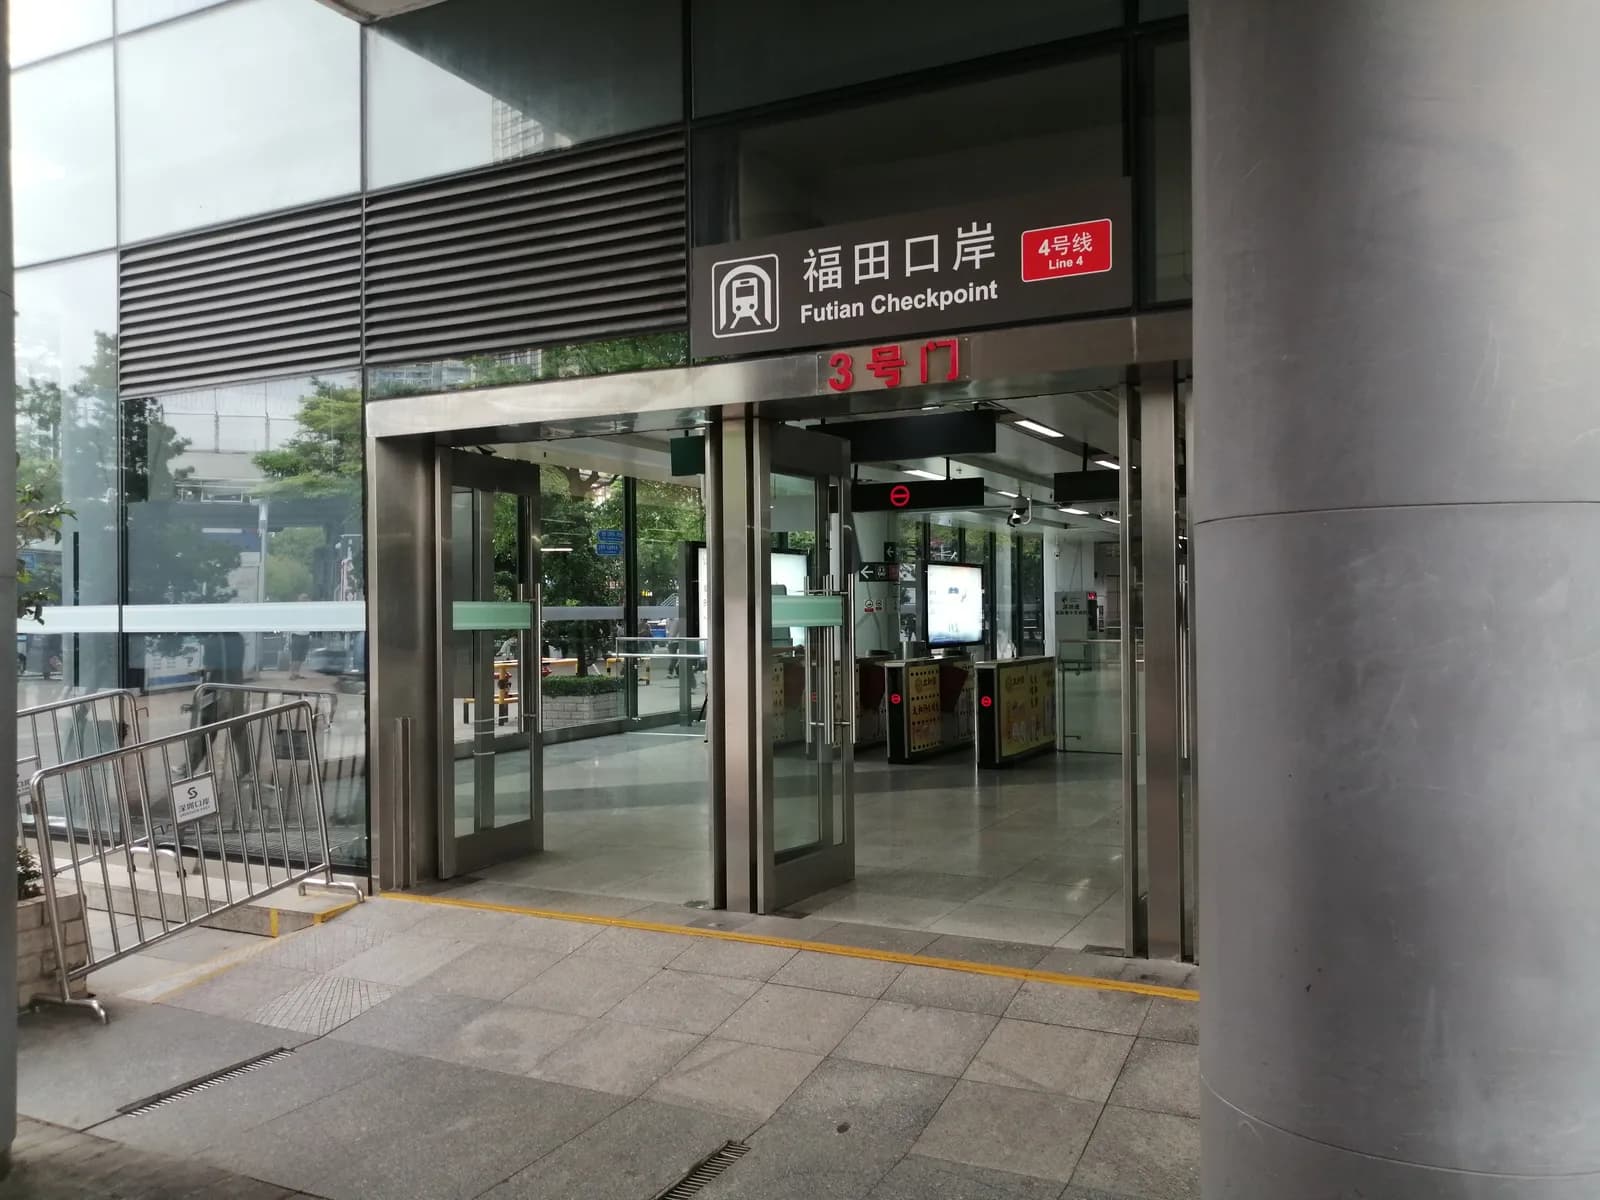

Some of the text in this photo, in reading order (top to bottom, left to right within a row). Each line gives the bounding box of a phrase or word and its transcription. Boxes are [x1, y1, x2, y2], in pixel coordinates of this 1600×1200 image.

[802, 222, 997, 294] 福田口岸
[1037, 231, 1094, 257] 4号线
[1047, 256, 1084, 271] Line 4
[799, 279, 999, 324] Futian Checkpoint
[827, 339, 959, 392] 3号门
